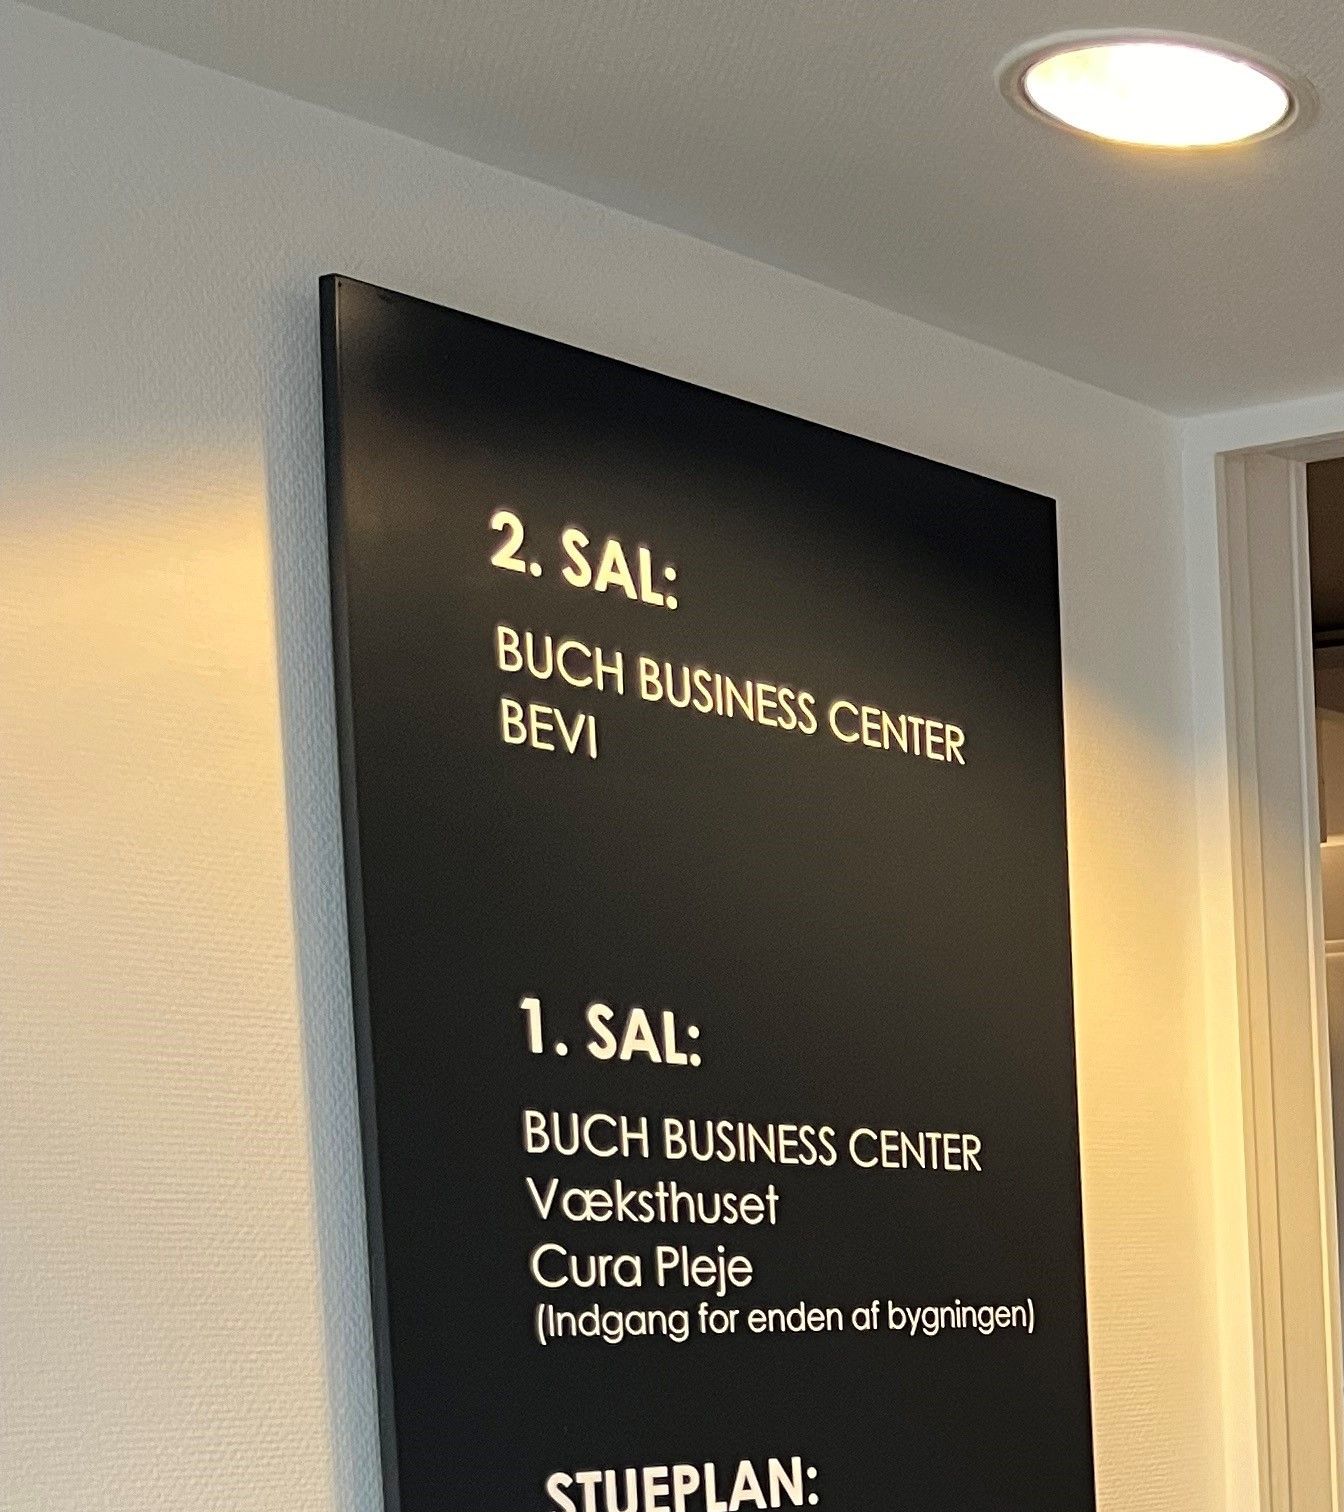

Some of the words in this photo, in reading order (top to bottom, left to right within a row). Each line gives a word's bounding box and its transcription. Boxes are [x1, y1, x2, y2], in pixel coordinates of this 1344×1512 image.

[488, 507, 543, 578] 2.
[560, 524, 679, 611] SAL:
[494, 625, 625, 697] BUCH
[637, 653, 819, 736] BUSINESS
[827, 697, 966, 766] CENTER
[500, 697, 599, 760] BEVI
[519, 996, 570, 1057] 1.
[585, 1002, 702, 1067] SAL:
[524, 1109, 650, 1160] BUCH
[663, 1117, 838, 1168] BUSINESS
[848, 1127, 982, 1172] CENTER
[525, 1176, 780, 1226] Væksthuset
[530, 1242, 643, 1289] Cura
[655, 1245, 753, 1298] Pleje
[535, 1303, 690, 1346] (Indgang
[697, 1301, 740, 1334] for
[747, 1300, 844, 1335] enden
[851, 1299, 881, 1331] af
[887, 1297, 1036, 1337] bygningen)
